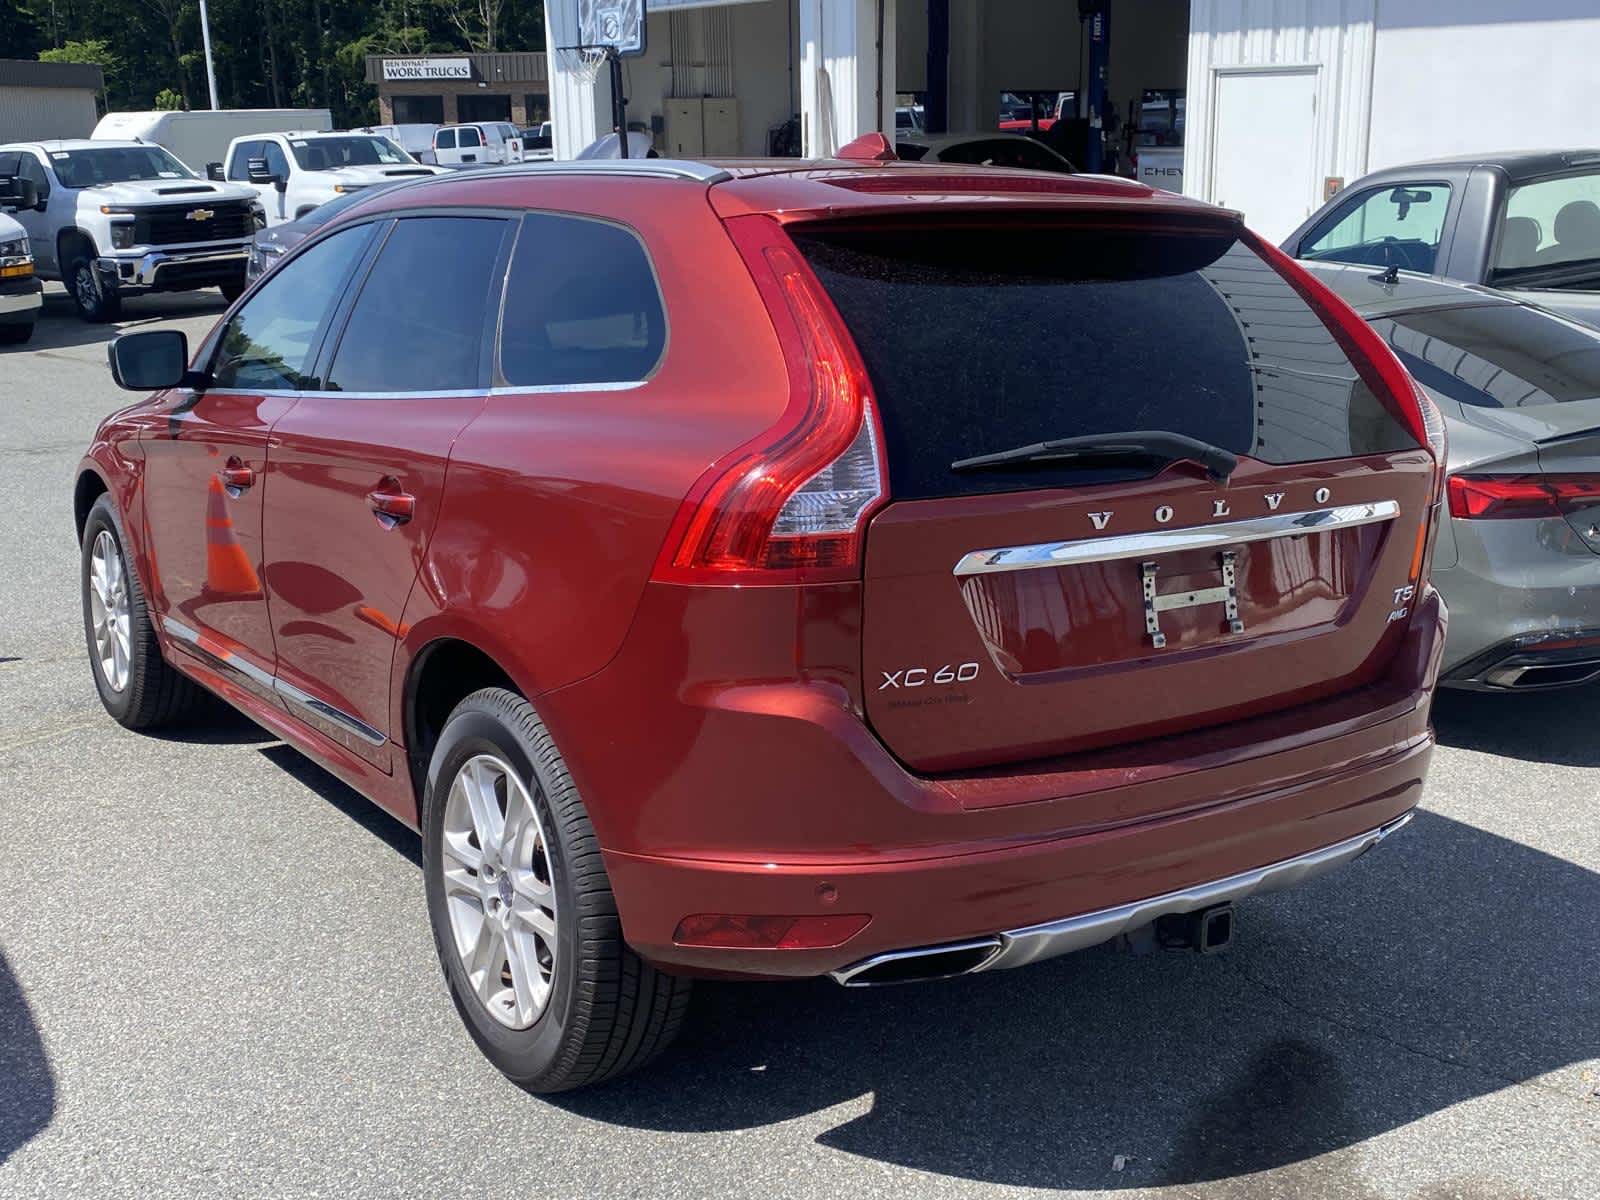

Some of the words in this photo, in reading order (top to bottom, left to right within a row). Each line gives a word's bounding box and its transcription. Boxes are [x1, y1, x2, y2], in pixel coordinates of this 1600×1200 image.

[386, 67, 422, 77] WORK
[424, 66, 468, 77] TRUCKS
[1087, 487, 1331, 530] VOLVO
[1393, 585, 1414, 604] T5
